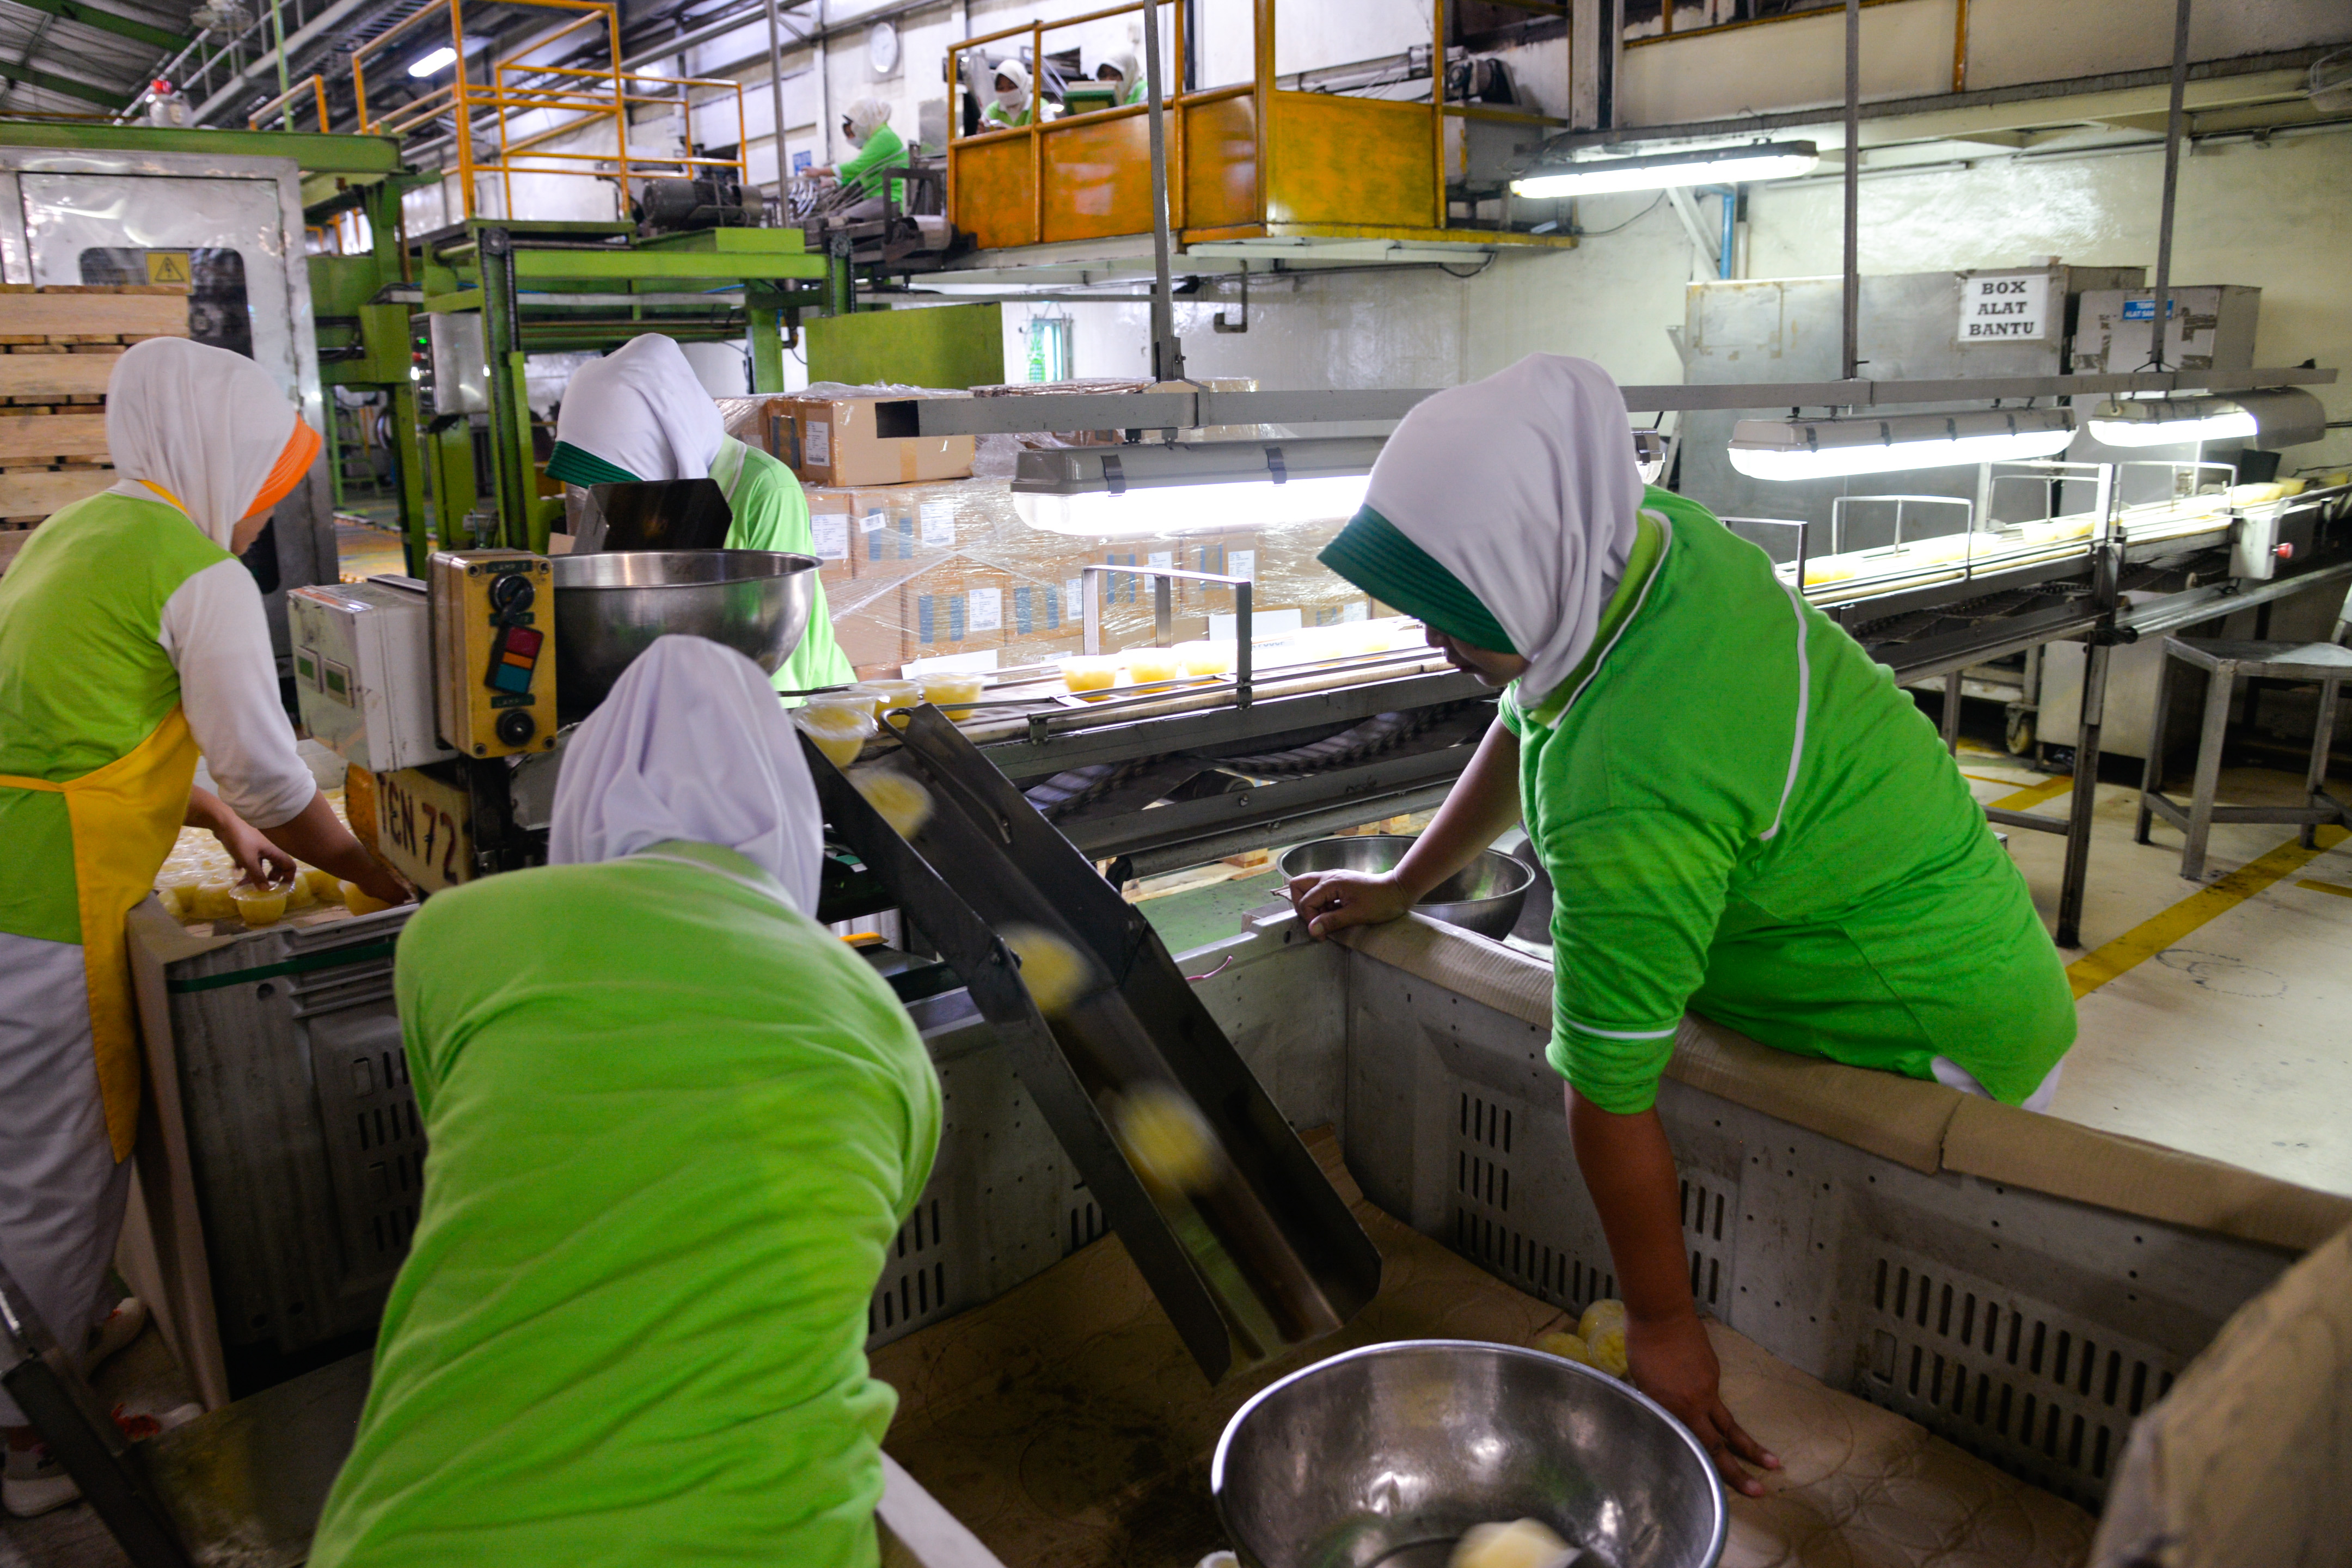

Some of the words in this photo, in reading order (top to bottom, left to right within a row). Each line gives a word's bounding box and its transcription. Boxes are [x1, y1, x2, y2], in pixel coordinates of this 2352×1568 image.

[1982, 281, 2026, 295] BOX
[1978, 301, 2027, 315] ALAT
[1969, 322, 2034, 335] BANTU
[422, 801, 458, 886] 72
